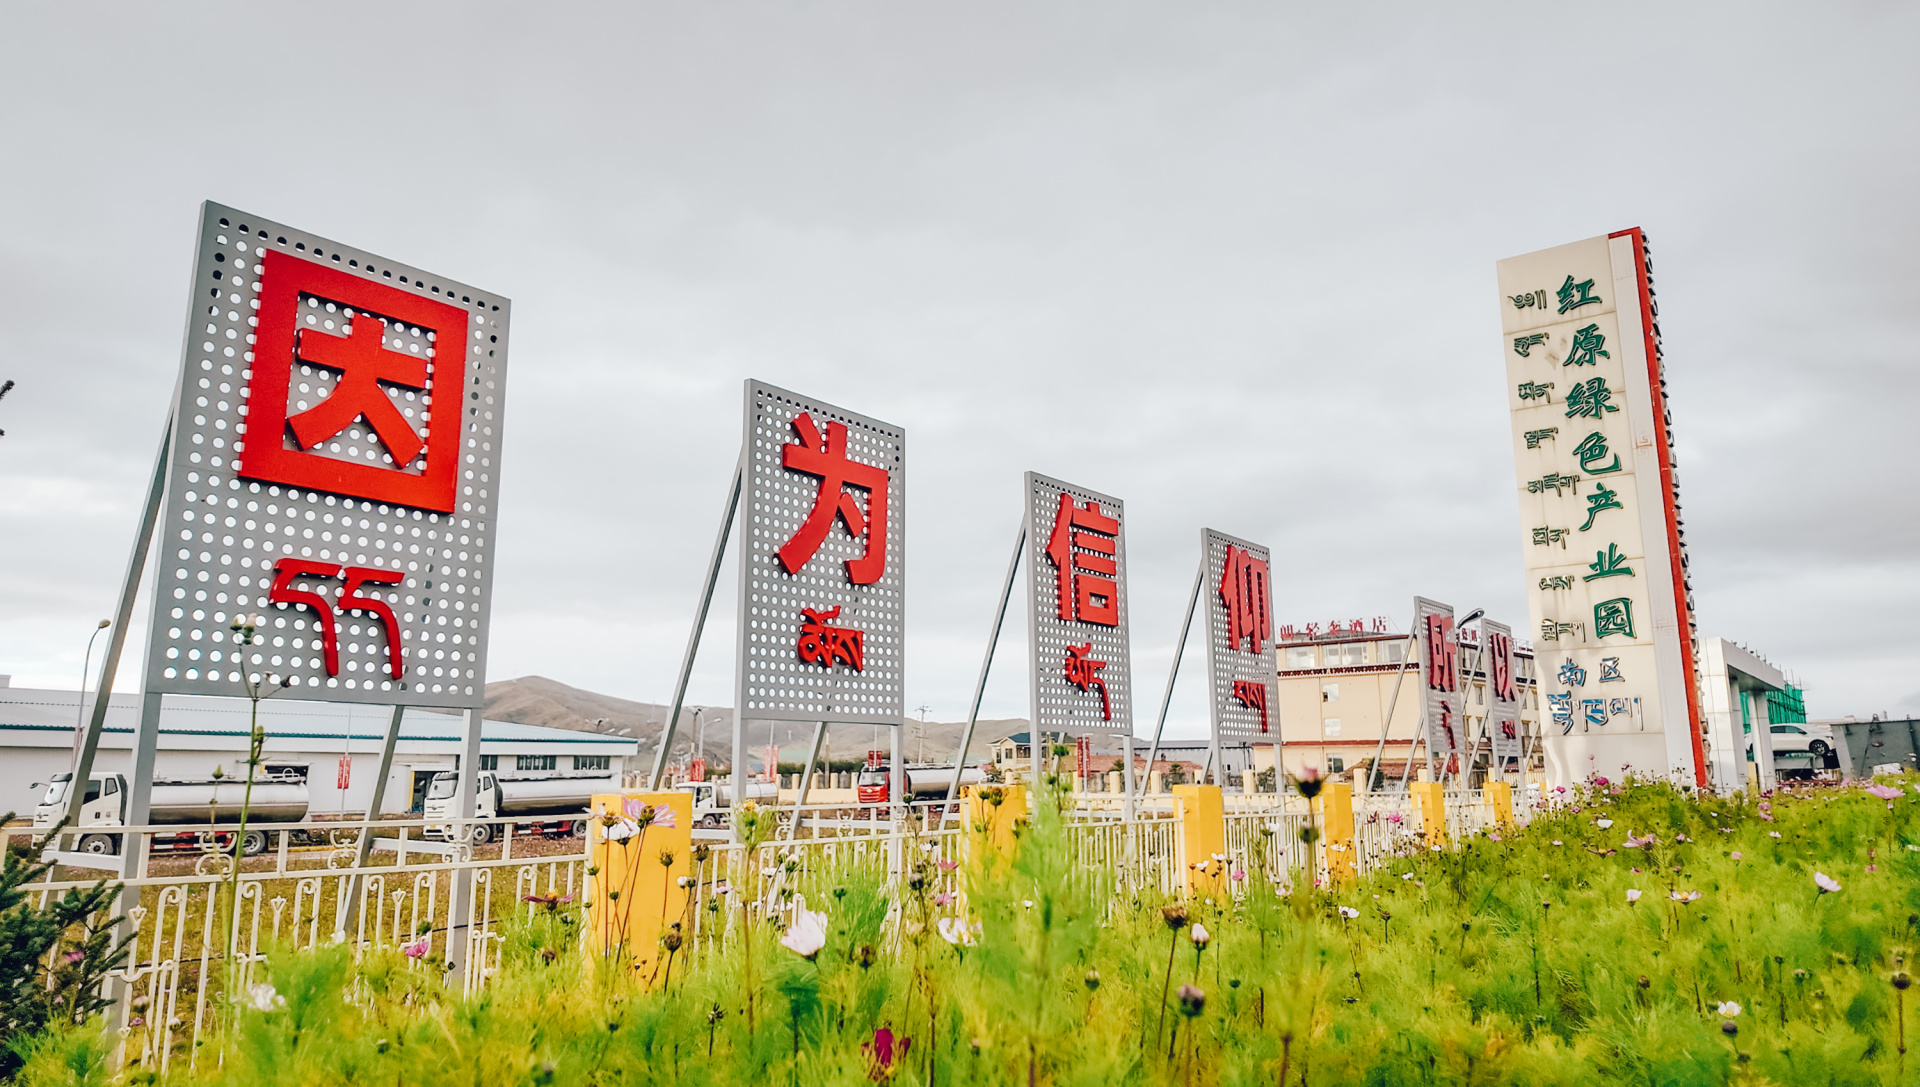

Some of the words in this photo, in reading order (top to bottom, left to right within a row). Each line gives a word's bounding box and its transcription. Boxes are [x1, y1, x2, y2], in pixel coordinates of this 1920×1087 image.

[237, 247, 469, 514] 因
[773, 412, 889, 585] 为
[1556, 275, 1638, 641] 红原绿色产业园
[1045, 493, 1119, 627] 信
[1218, 544, 1271, 654] 仰
[1427, 614, 1456, 692] 所
[1490, 632, 1518, 702] 以
[1557, 656, 1626, 688] 南区
